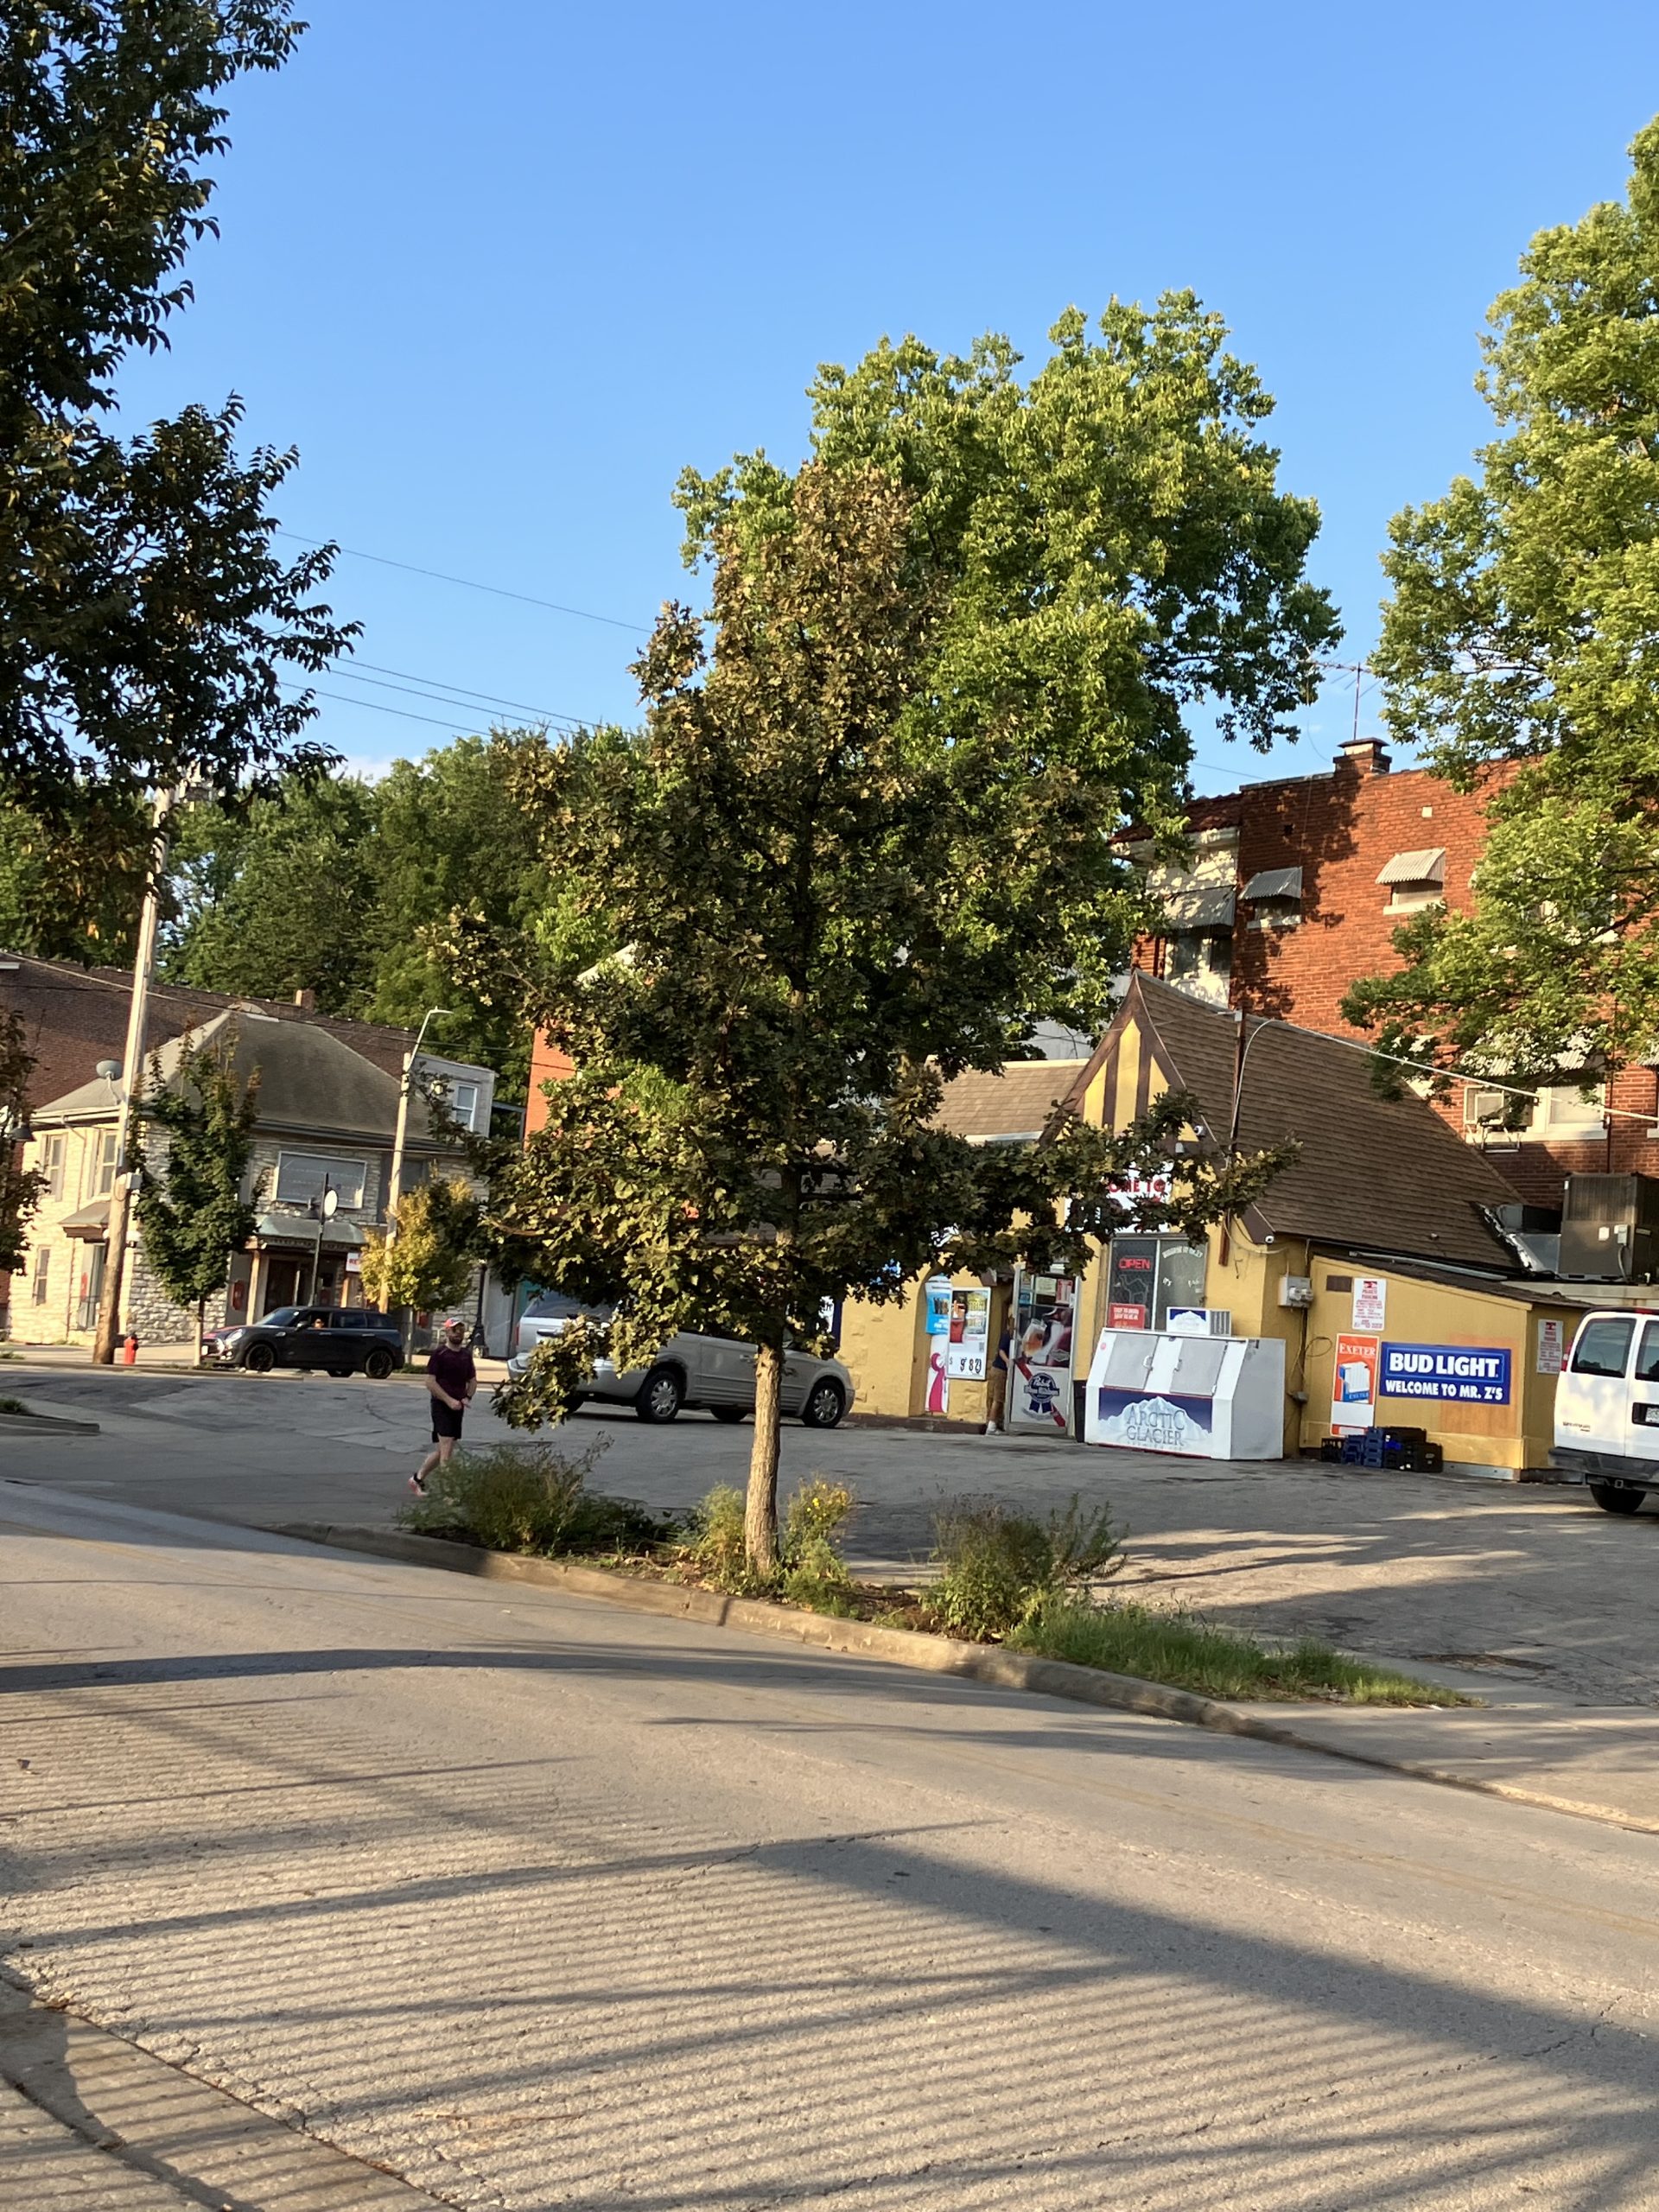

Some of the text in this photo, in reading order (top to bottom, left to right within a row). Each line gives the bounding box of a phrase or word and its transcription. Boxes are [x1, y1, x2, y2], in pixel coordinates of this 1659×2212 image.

[1119, 1257, 1152, 1270] OPEN
[1339, 1342, 1376, 1357] EXETER
[1389, 1352, 1434, 1373] BUD
[1385, 1379, 1503, 1402] WELCOME TO MR. Z'S
[1126, 1404, 1186, 1431] ARCTIC
[1126, 1425, 1185, 1446] GLACIER
